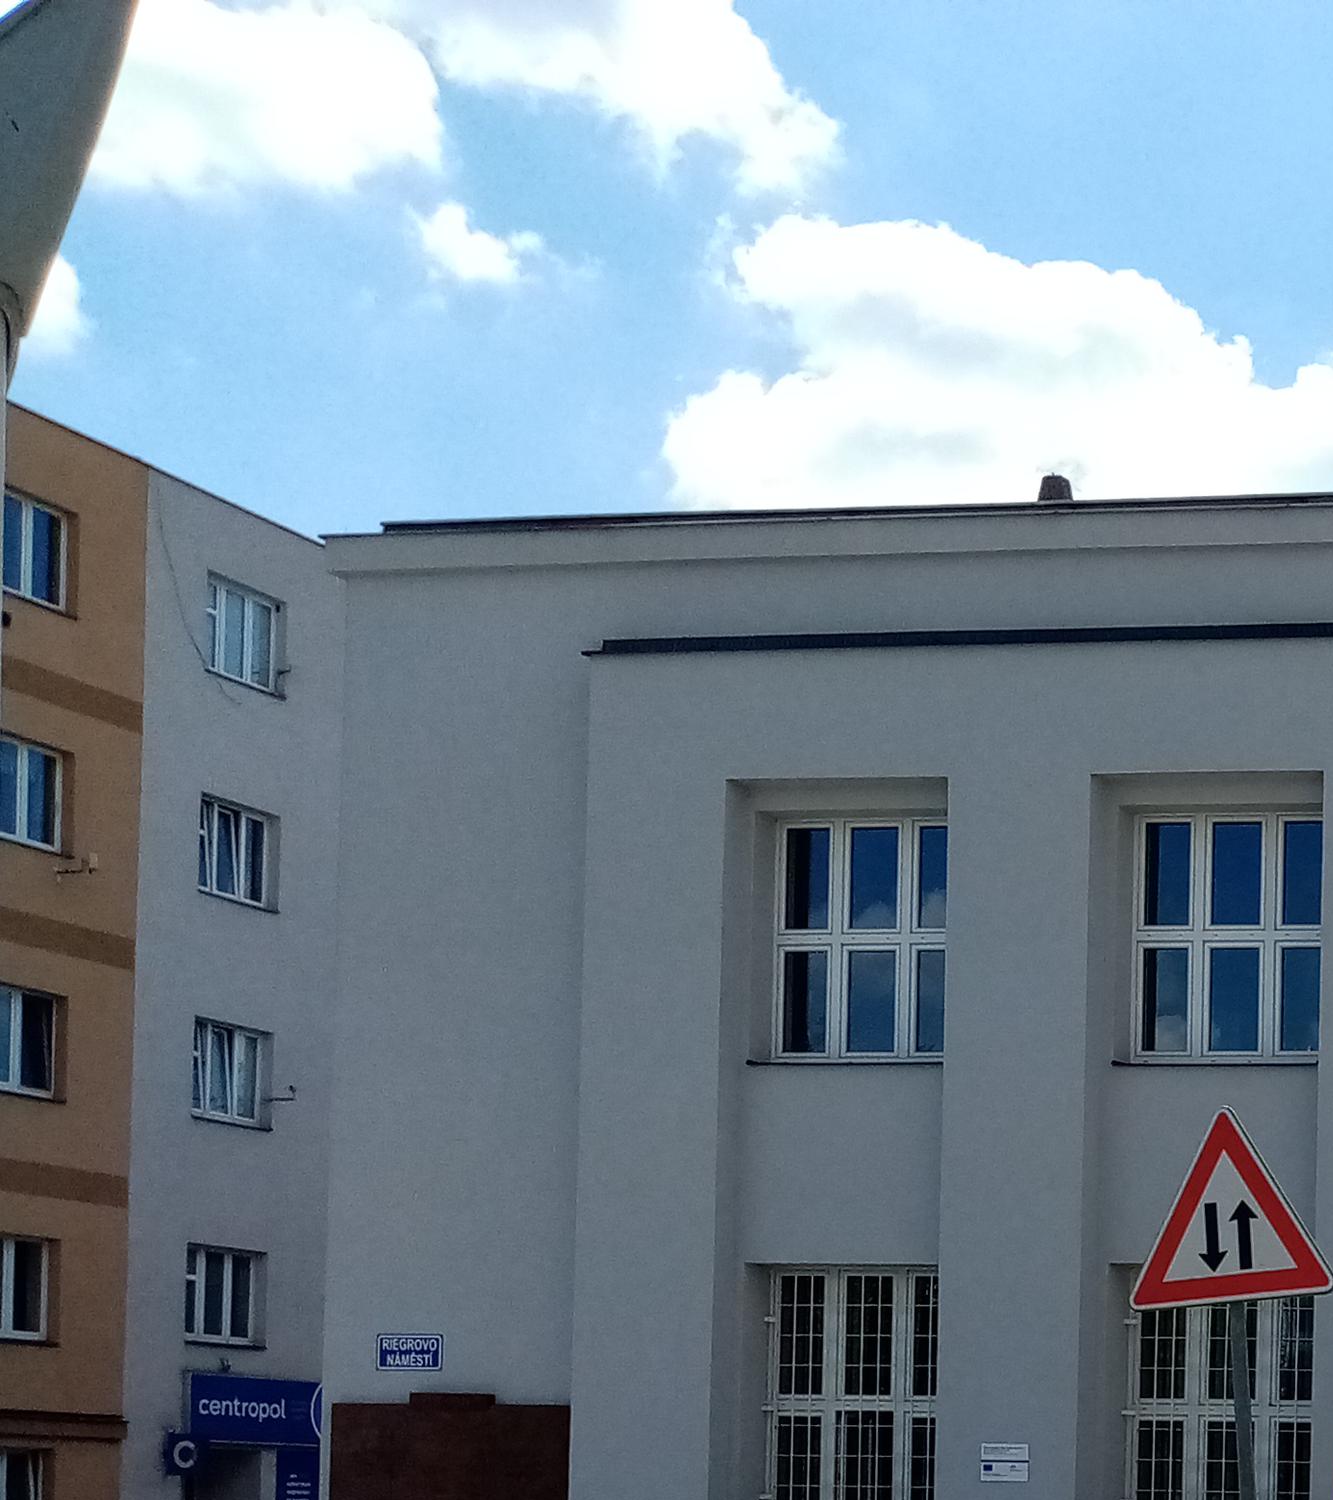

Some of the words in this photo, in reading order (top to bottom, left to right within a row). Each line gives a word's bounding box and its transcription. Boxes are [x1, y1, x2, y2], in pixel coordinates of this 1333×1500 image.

[382, 1338, 438, 1351] RIEGROVO
[386, 1351, 434, 1367] NÁMĚSTÍ
[199, 1396, 286, 1423] centropol
